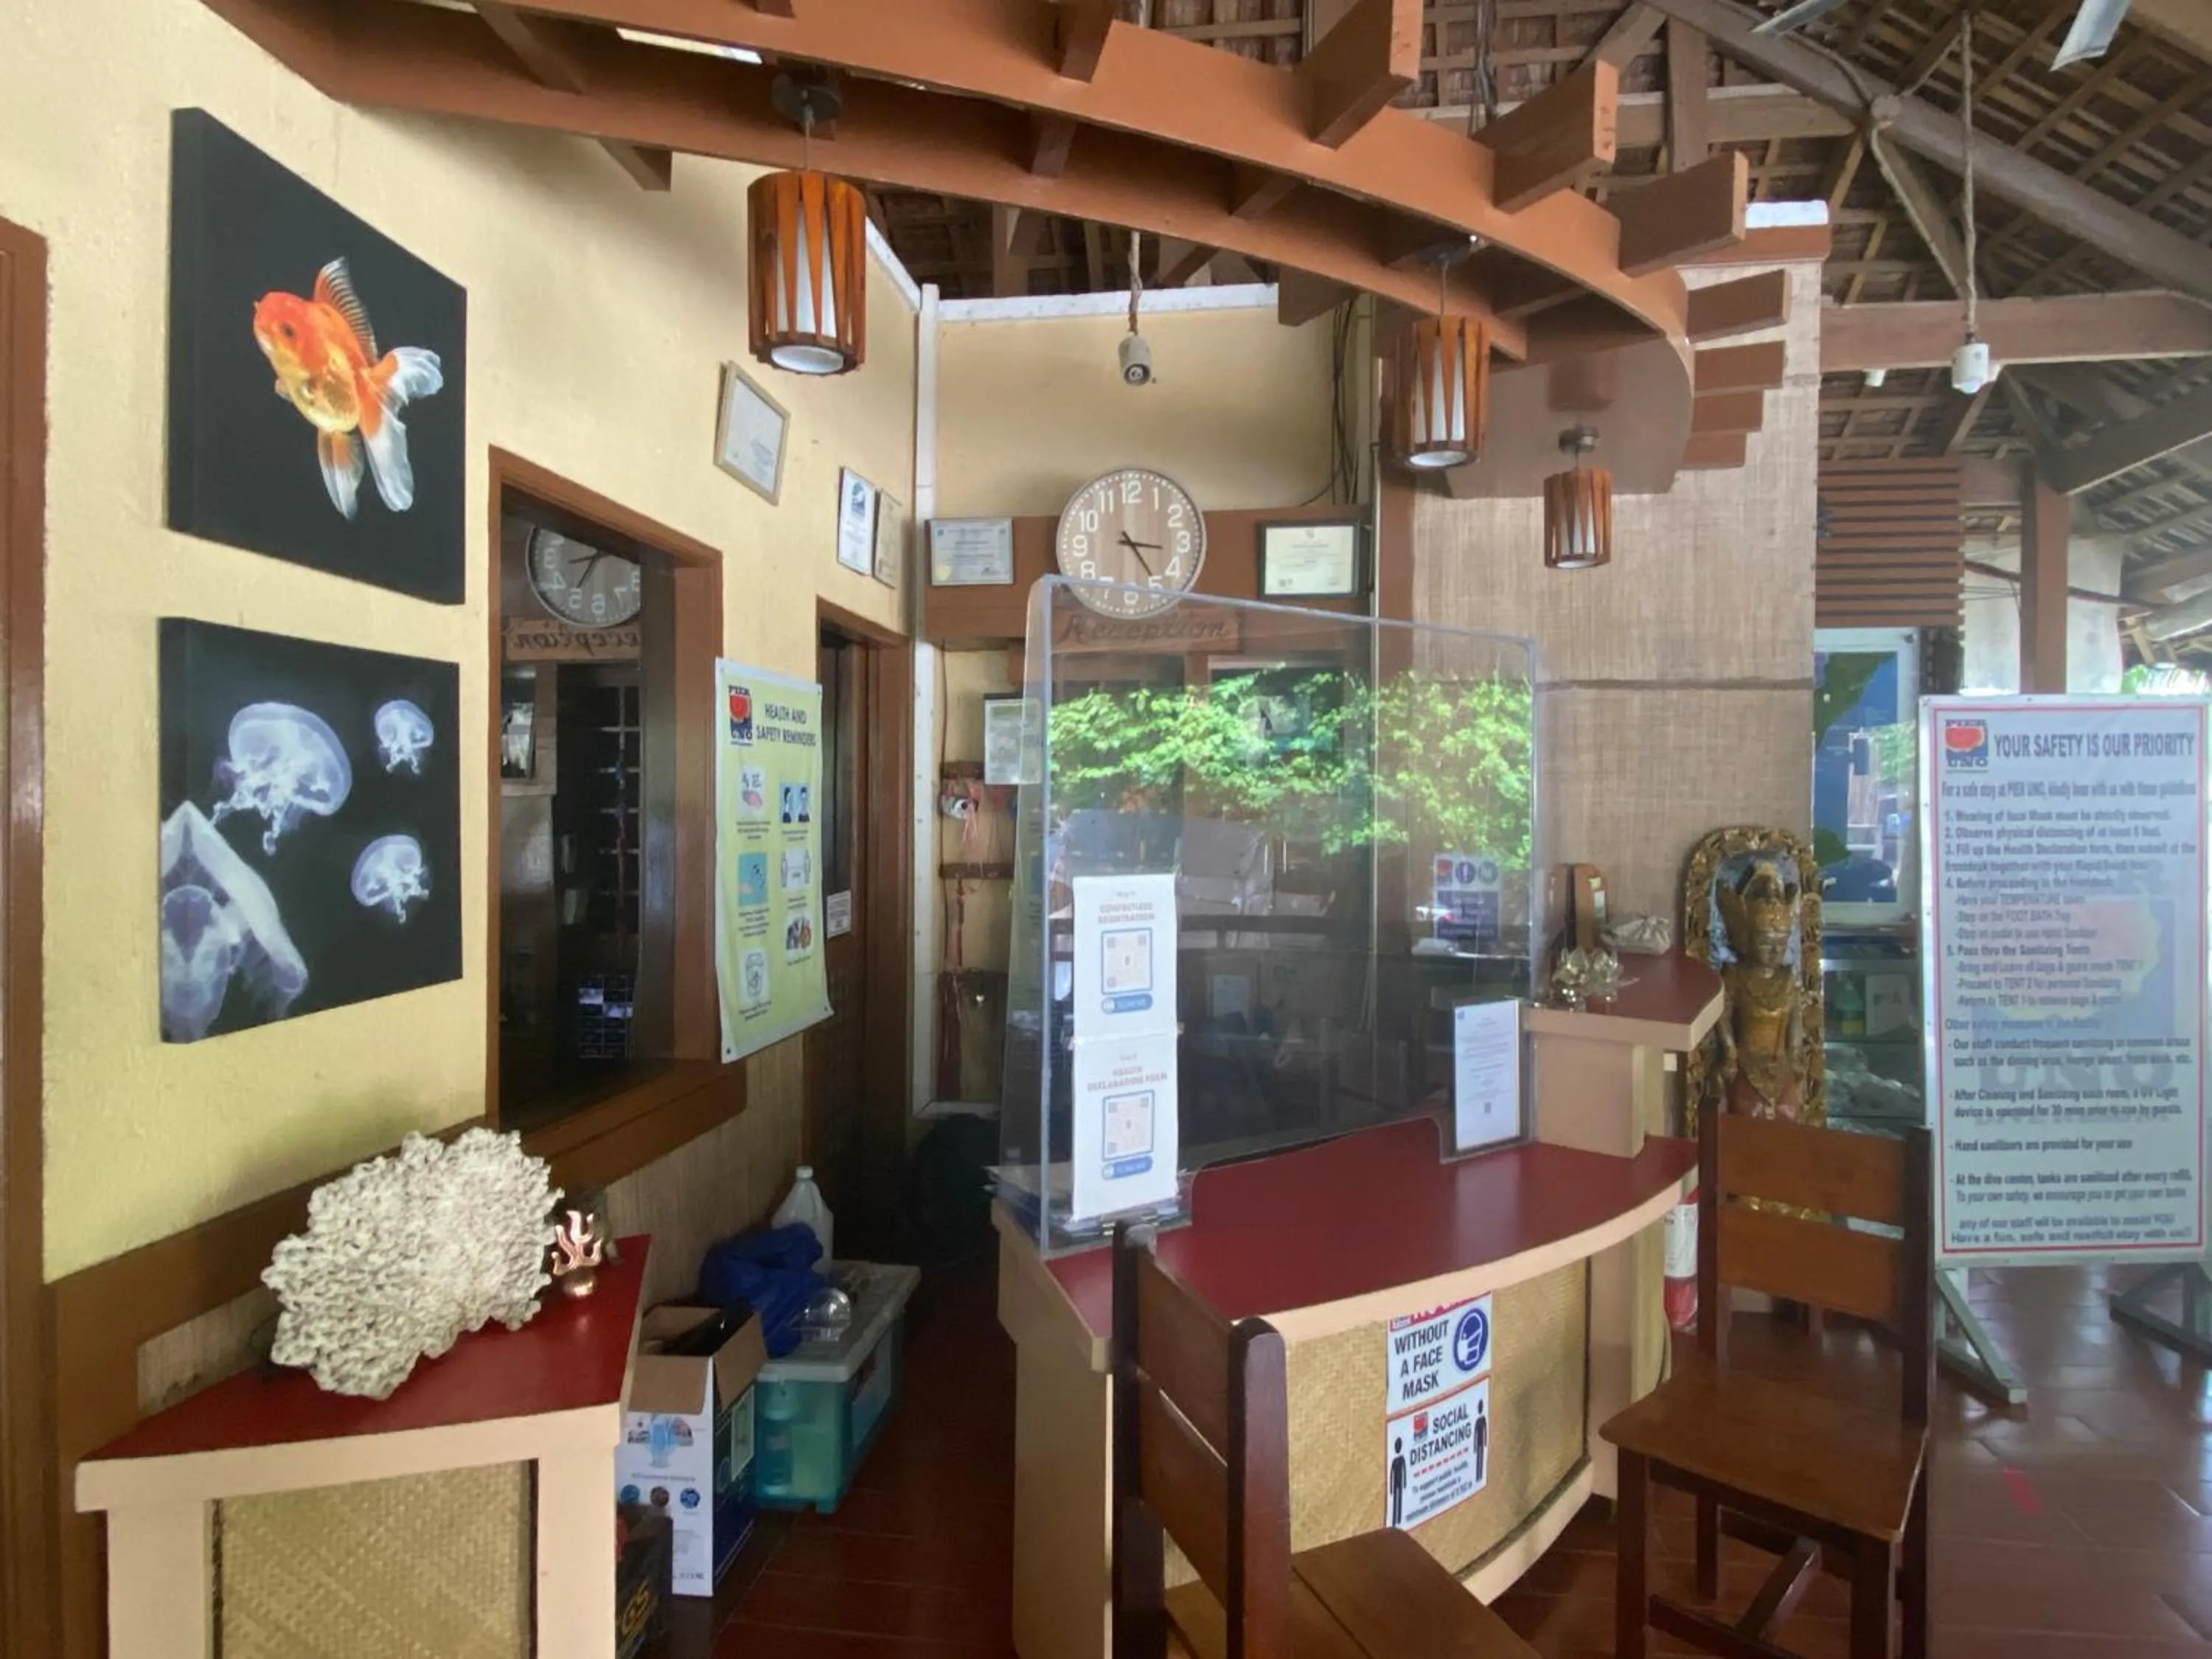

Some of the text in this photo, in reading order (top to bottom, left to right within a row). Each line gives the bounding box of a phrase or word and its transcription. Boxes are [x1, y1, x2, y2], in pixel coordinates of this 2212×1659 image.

[1099, 490, 1113, 513] 11
[1121, 481, 1142, 504] 12
[1152, 487, 1159, 511] 1
[1079, 509, 1099, 532] 10
[1168, 504, 1183, 528] 2
[1073, 535, 1088, 557] 9
[1177, 531, 1191, 553] 3
[1080, 561, 1096, 580] 8
[1165, 556, 1181, 579] 4
[765, 703, 807, 724] HEALTH AND
[757, 725, 781, 742] SAFETY
[1994, 731, 2195, 759] YOUR SAFETY IS OUR PRIORITY
[1947, 757, 1989, 768] UNO
[1955, 1088, 1976, 1100] After
[1394, 1319, 1450, 1355] WITHOUT
[1401, 1346, 1444, 1377] A FACE
[1402, 1370, 1439, 1400] MASK
[1433, 1403, 1469, 1434] SOCIAL
[1410, 1422, 1472, 1466] DISTANCING
